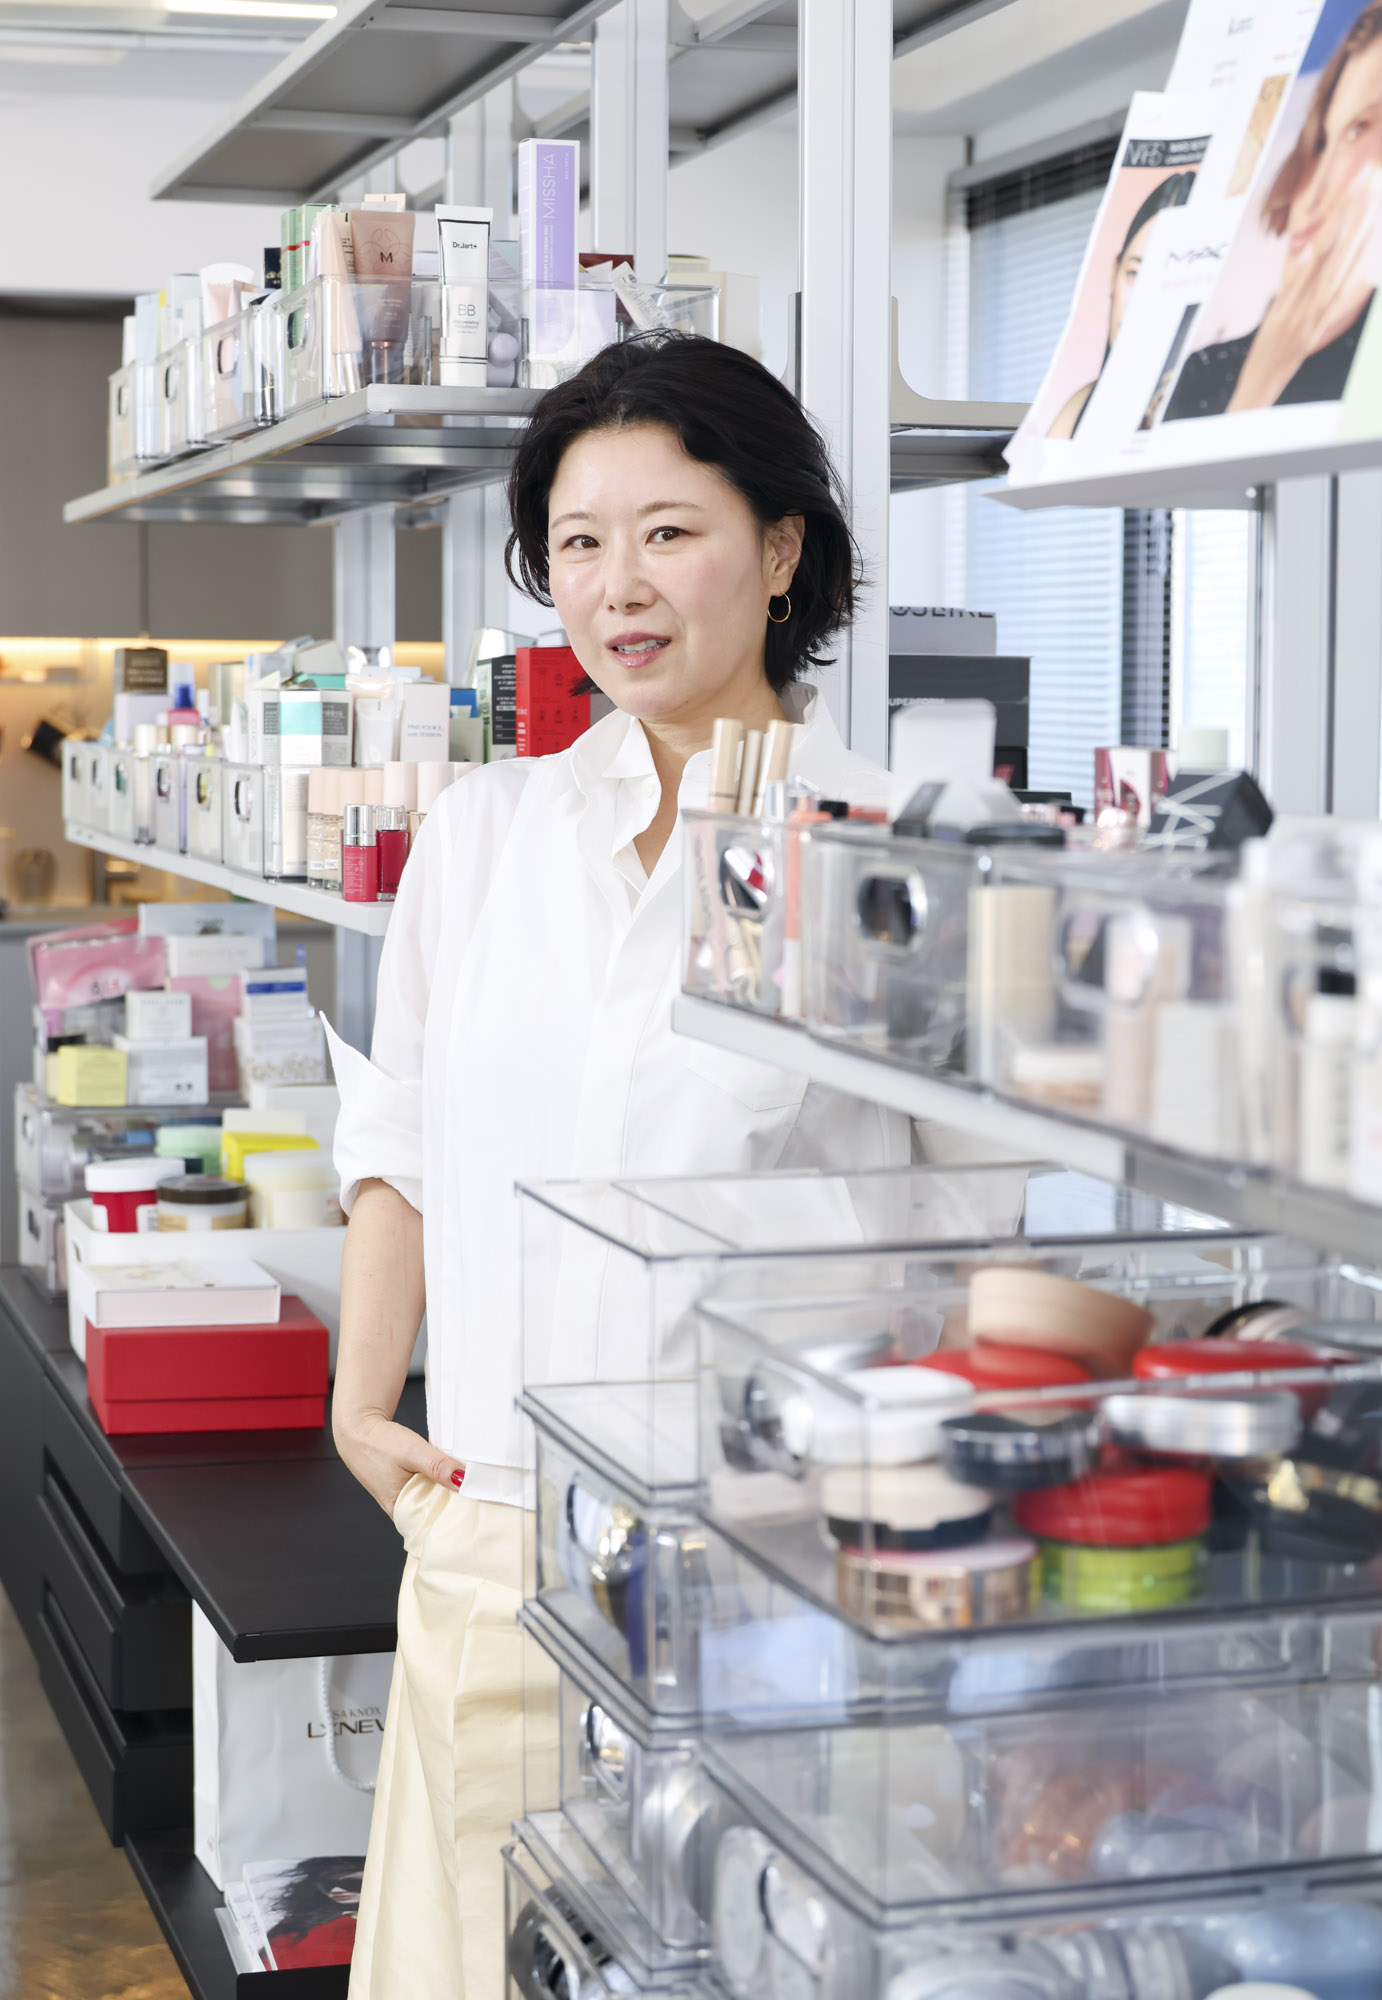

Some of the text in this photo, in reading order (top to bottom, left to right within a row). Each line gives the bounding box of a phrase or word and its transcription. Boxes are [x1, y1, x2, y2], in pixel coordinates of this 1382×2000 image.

[543, 152, 556, 219] MISSHA
[452, 241, 478, 249] Dr.Jart+
[380, 251, 393, 263] M
[457, 304, 476, 317] BB
[350, 1705, 382, 1718] KNOX
